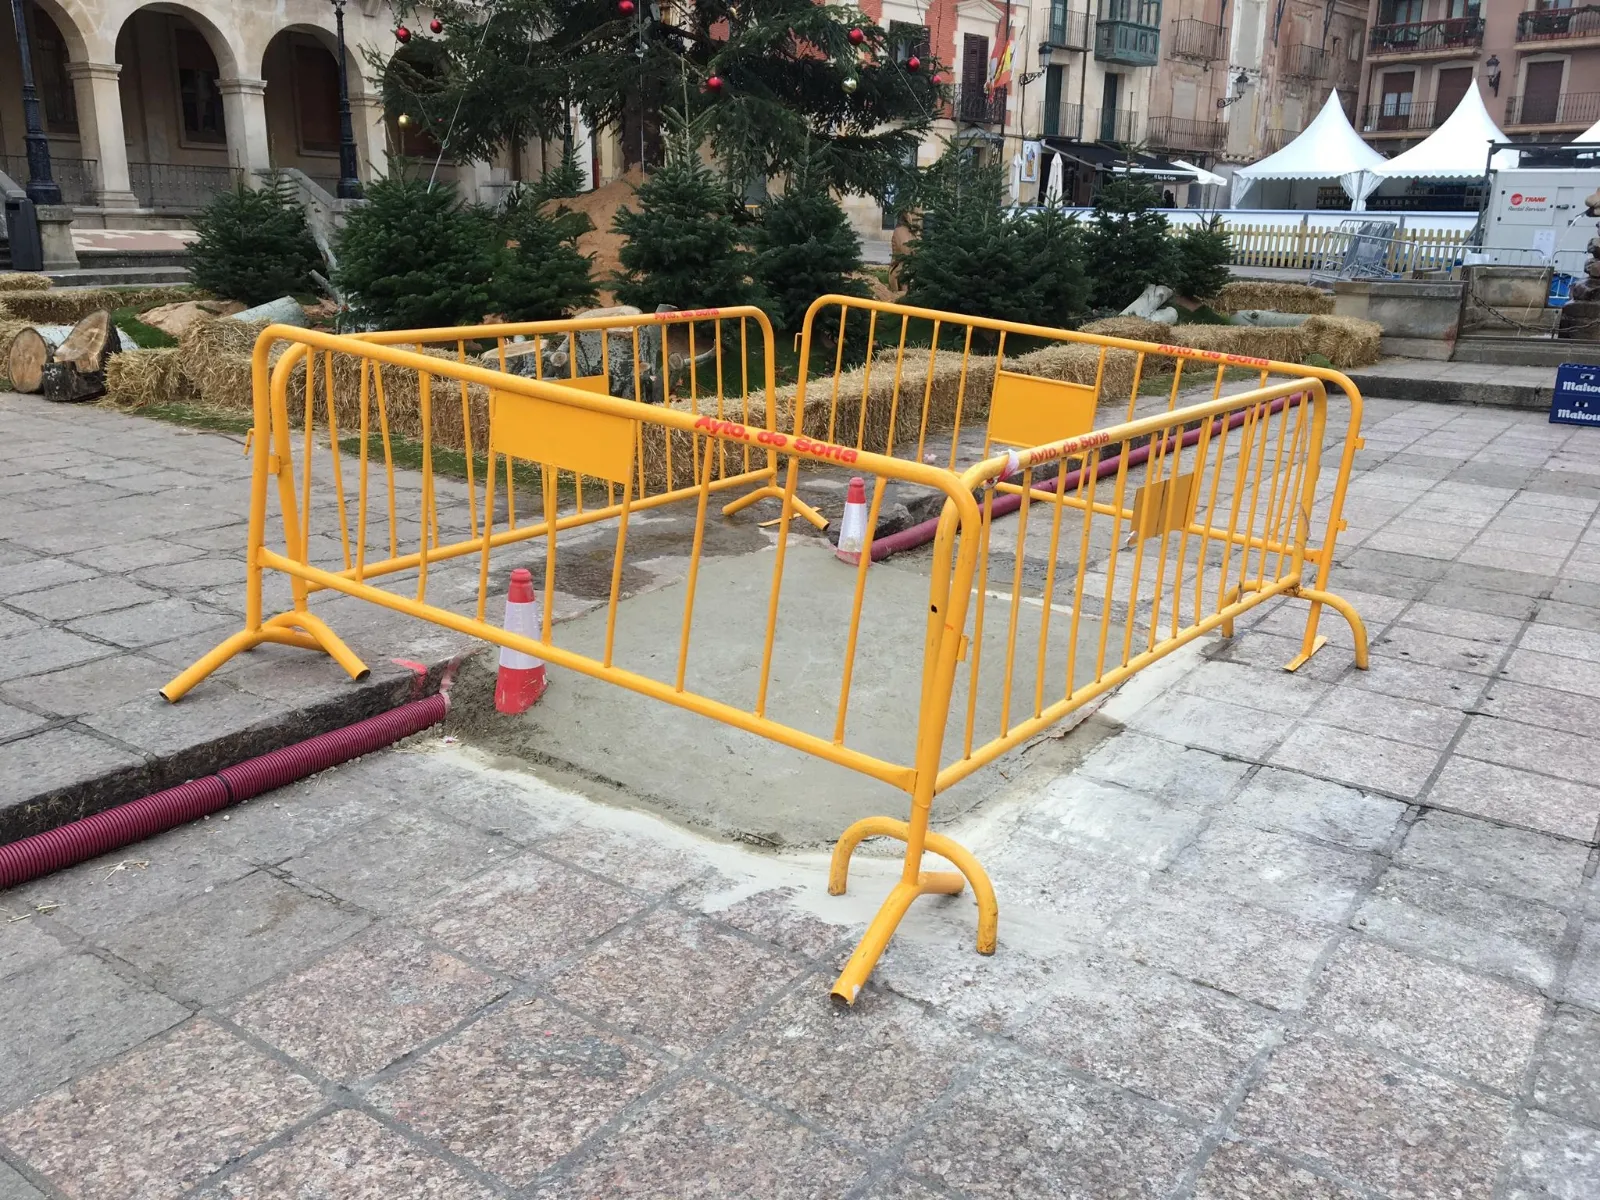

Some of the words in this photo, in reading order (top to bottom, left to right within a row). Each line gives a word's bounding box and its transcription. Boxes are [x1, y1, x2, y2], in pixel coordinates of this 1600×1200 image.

[1157, 344, 1196, 356] Ayto.
[1201, 350, 1222, 360] de
[1226, 353, 1270, 366] Soria
[1563, 381, 1600, 393] Maho
[694, 416, 750, 441] Ayto.
[757, 431, 787, 447] de
[793, 437, 858, 464] Soria
[1029, 447, 1060, 464] Ayto.
[1063, 440, 1078, 454] de
[1079, 432, 1110, 450] Soria
